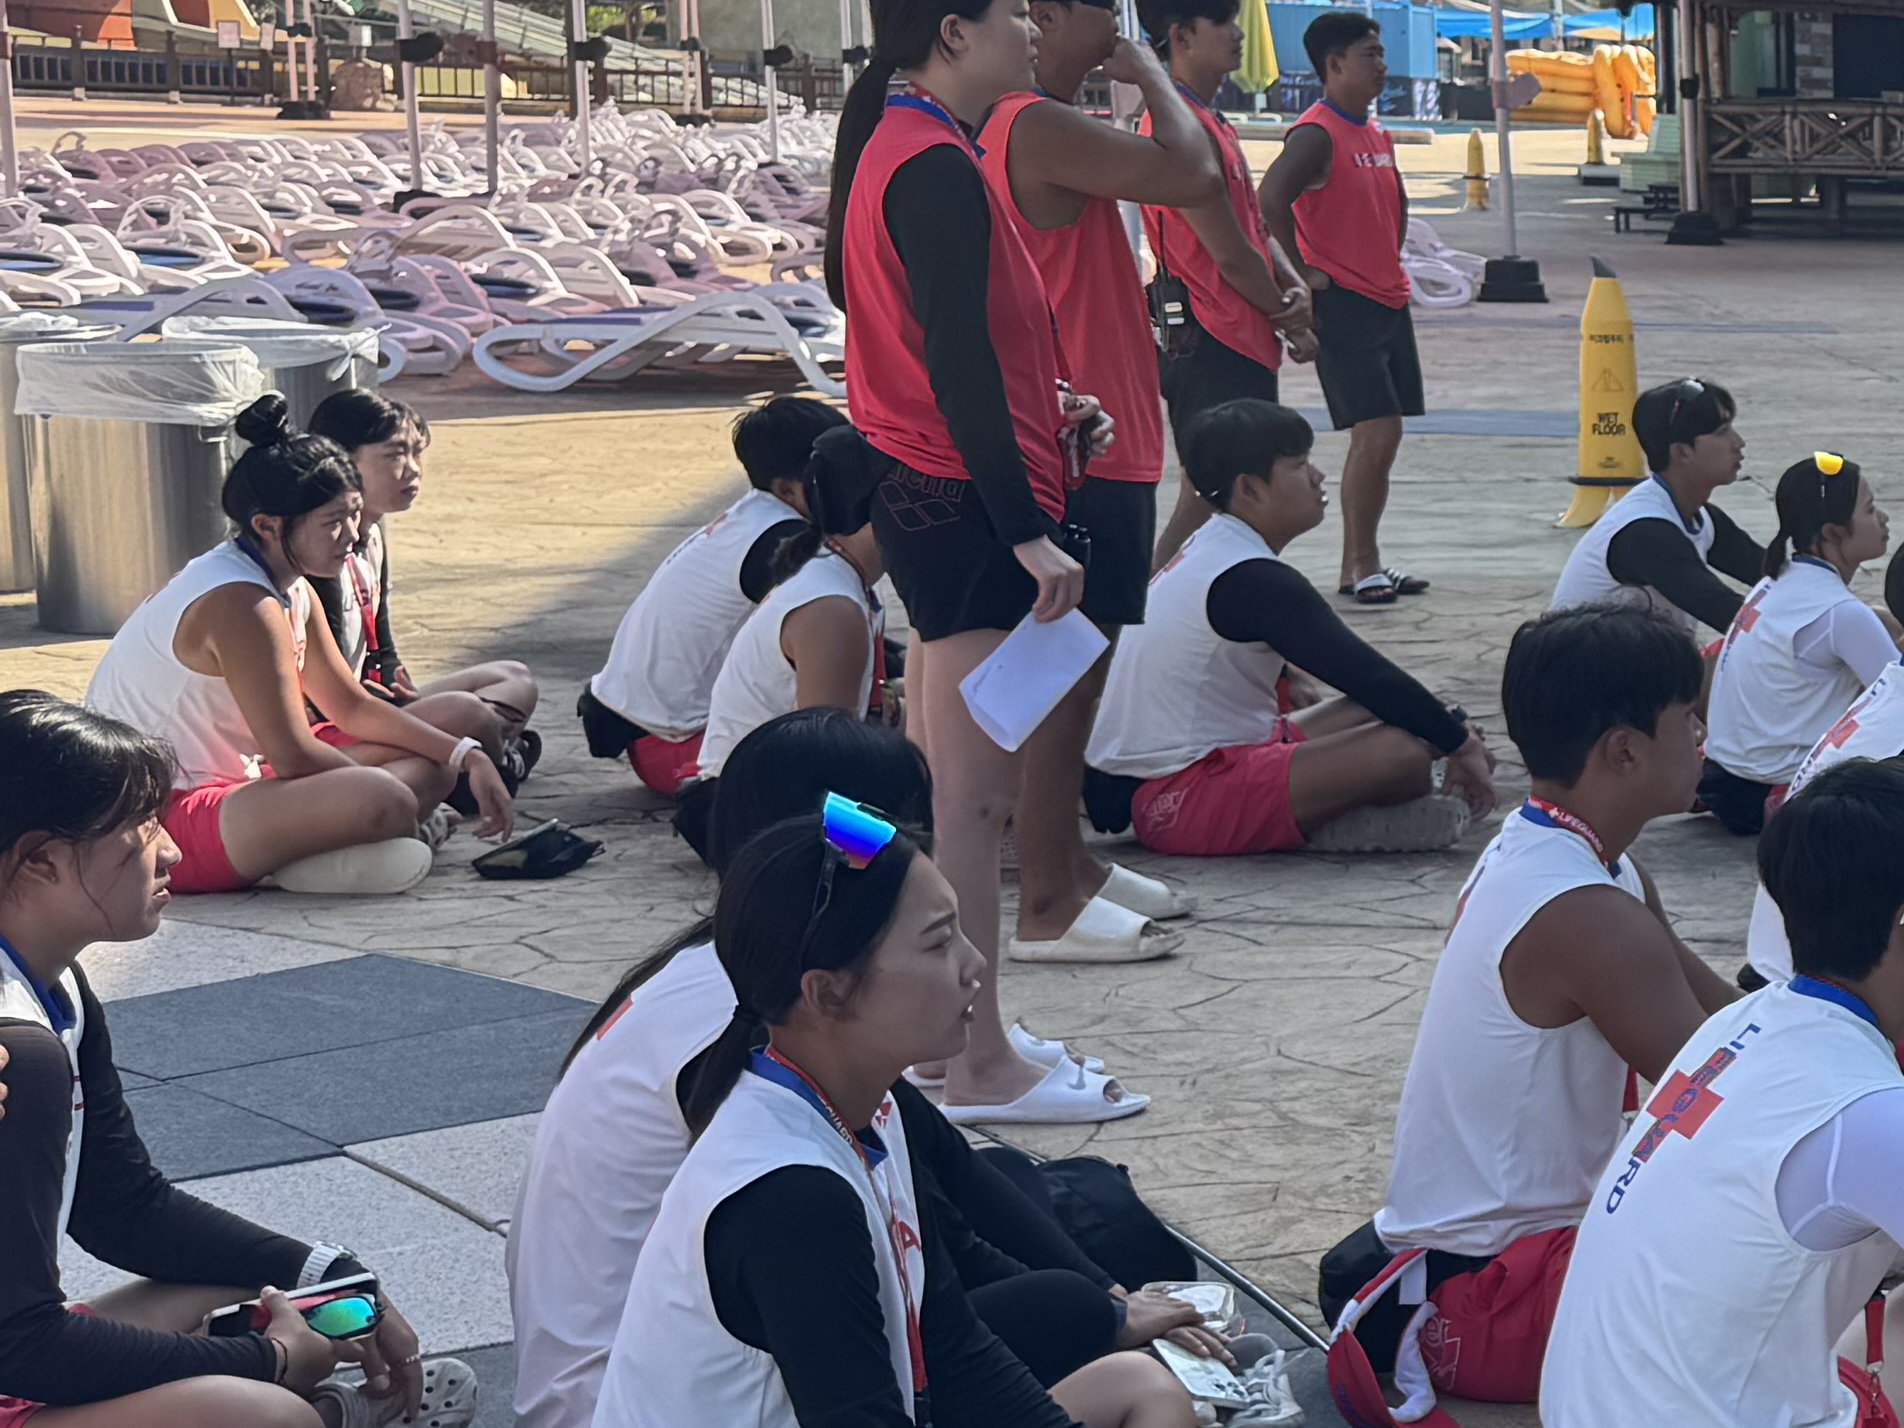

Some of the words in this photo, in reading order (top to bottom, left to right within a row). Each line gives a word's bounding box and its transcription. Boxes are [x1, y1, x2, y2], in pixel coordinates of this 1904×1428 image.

[1592, 424, 1625, 435] FLOOR
[1597, 412, 1619, 424] WET
[1558, 811, 1605, 853] LIFEGUARD
[1606, 1021, 1762, 1215] LIFEGUARD
